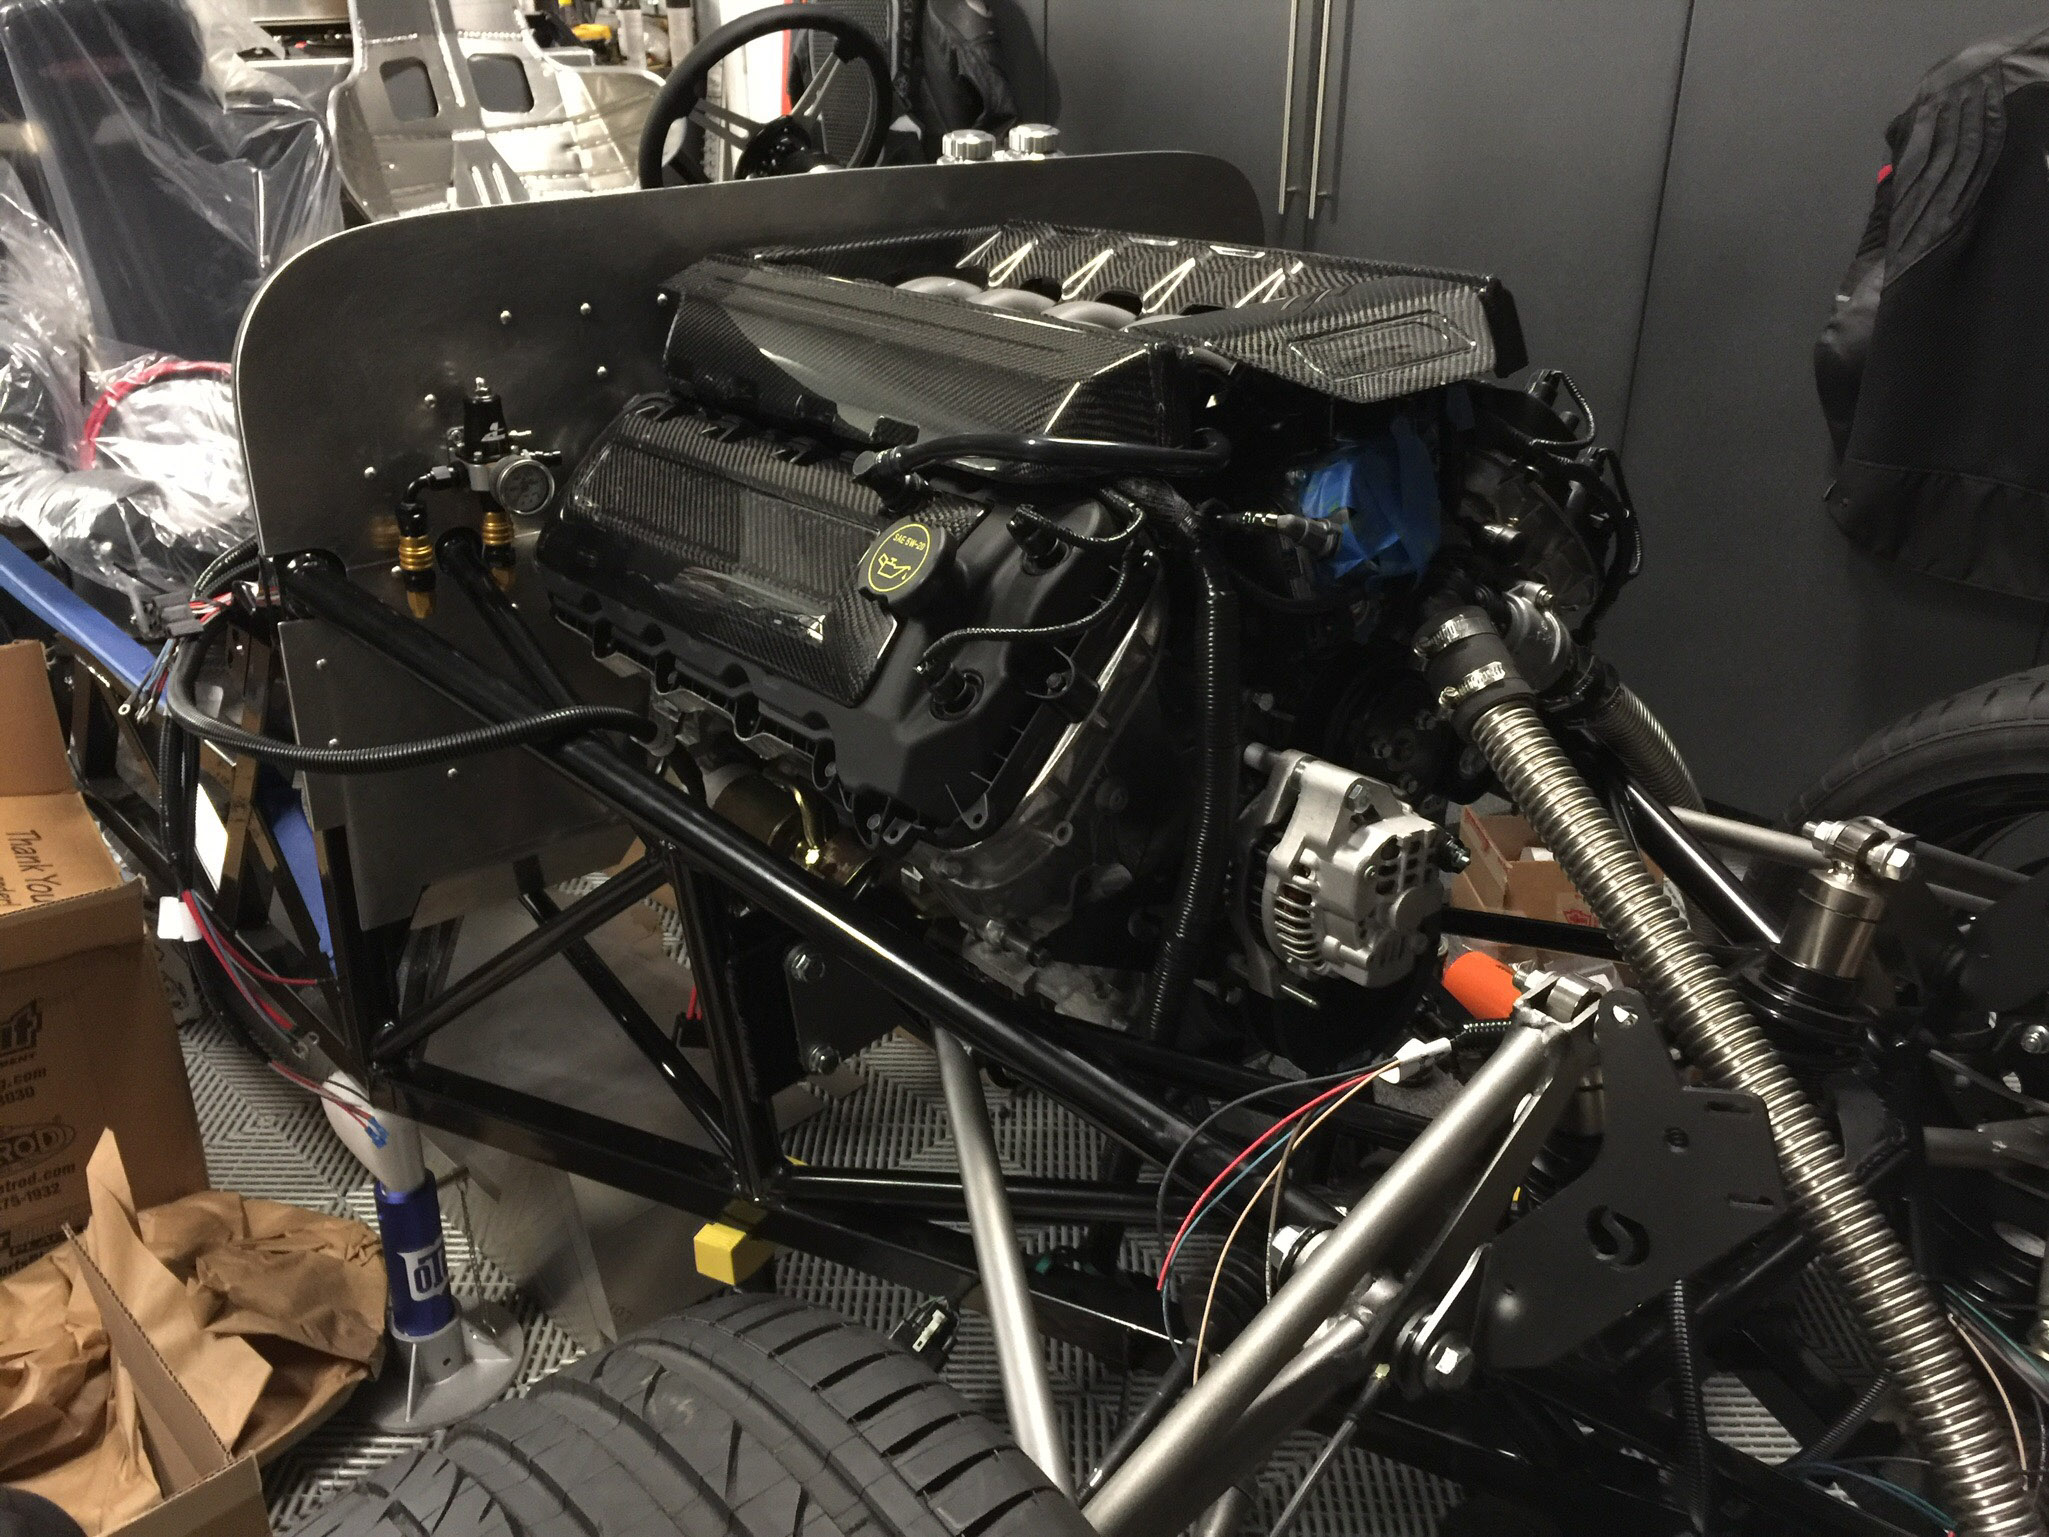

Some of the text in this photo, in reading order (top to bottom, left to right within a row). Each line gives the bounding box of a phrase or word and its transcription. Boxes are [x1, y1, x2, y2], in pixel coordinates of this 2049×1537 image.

[893, 533, 926, 551] SAE 5W-20
[6, 830, 62, 903] Thank You
